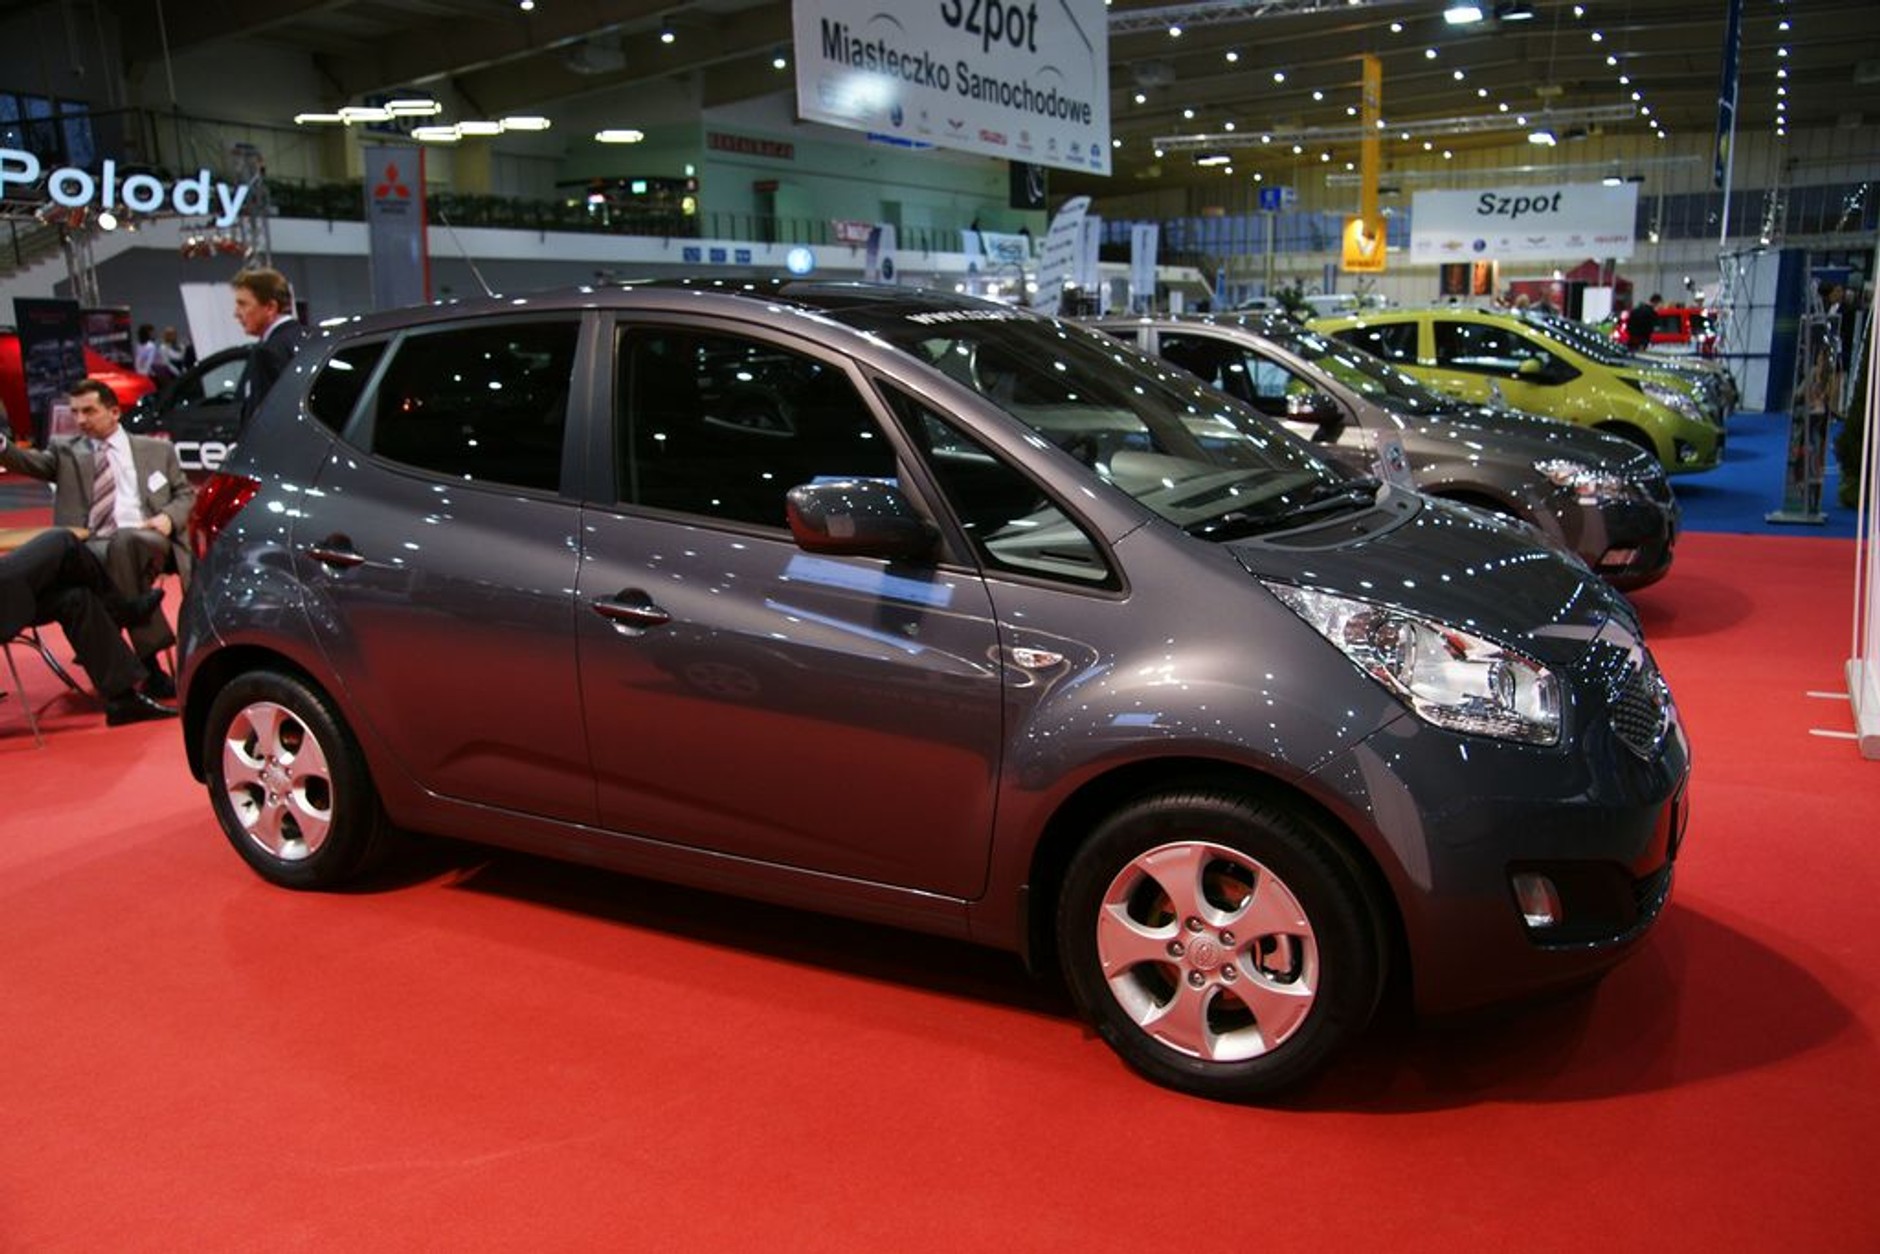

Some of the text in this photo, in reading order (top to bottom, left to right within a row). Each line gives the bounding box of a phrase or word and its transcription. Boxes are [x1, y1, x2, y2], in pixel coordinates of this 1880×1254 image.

[821, 18, 1092, 126] Miasteczko Samochodowe
[0, 148, 249, 227] Polody
[1477, 191, 1562, 218] Szpot
